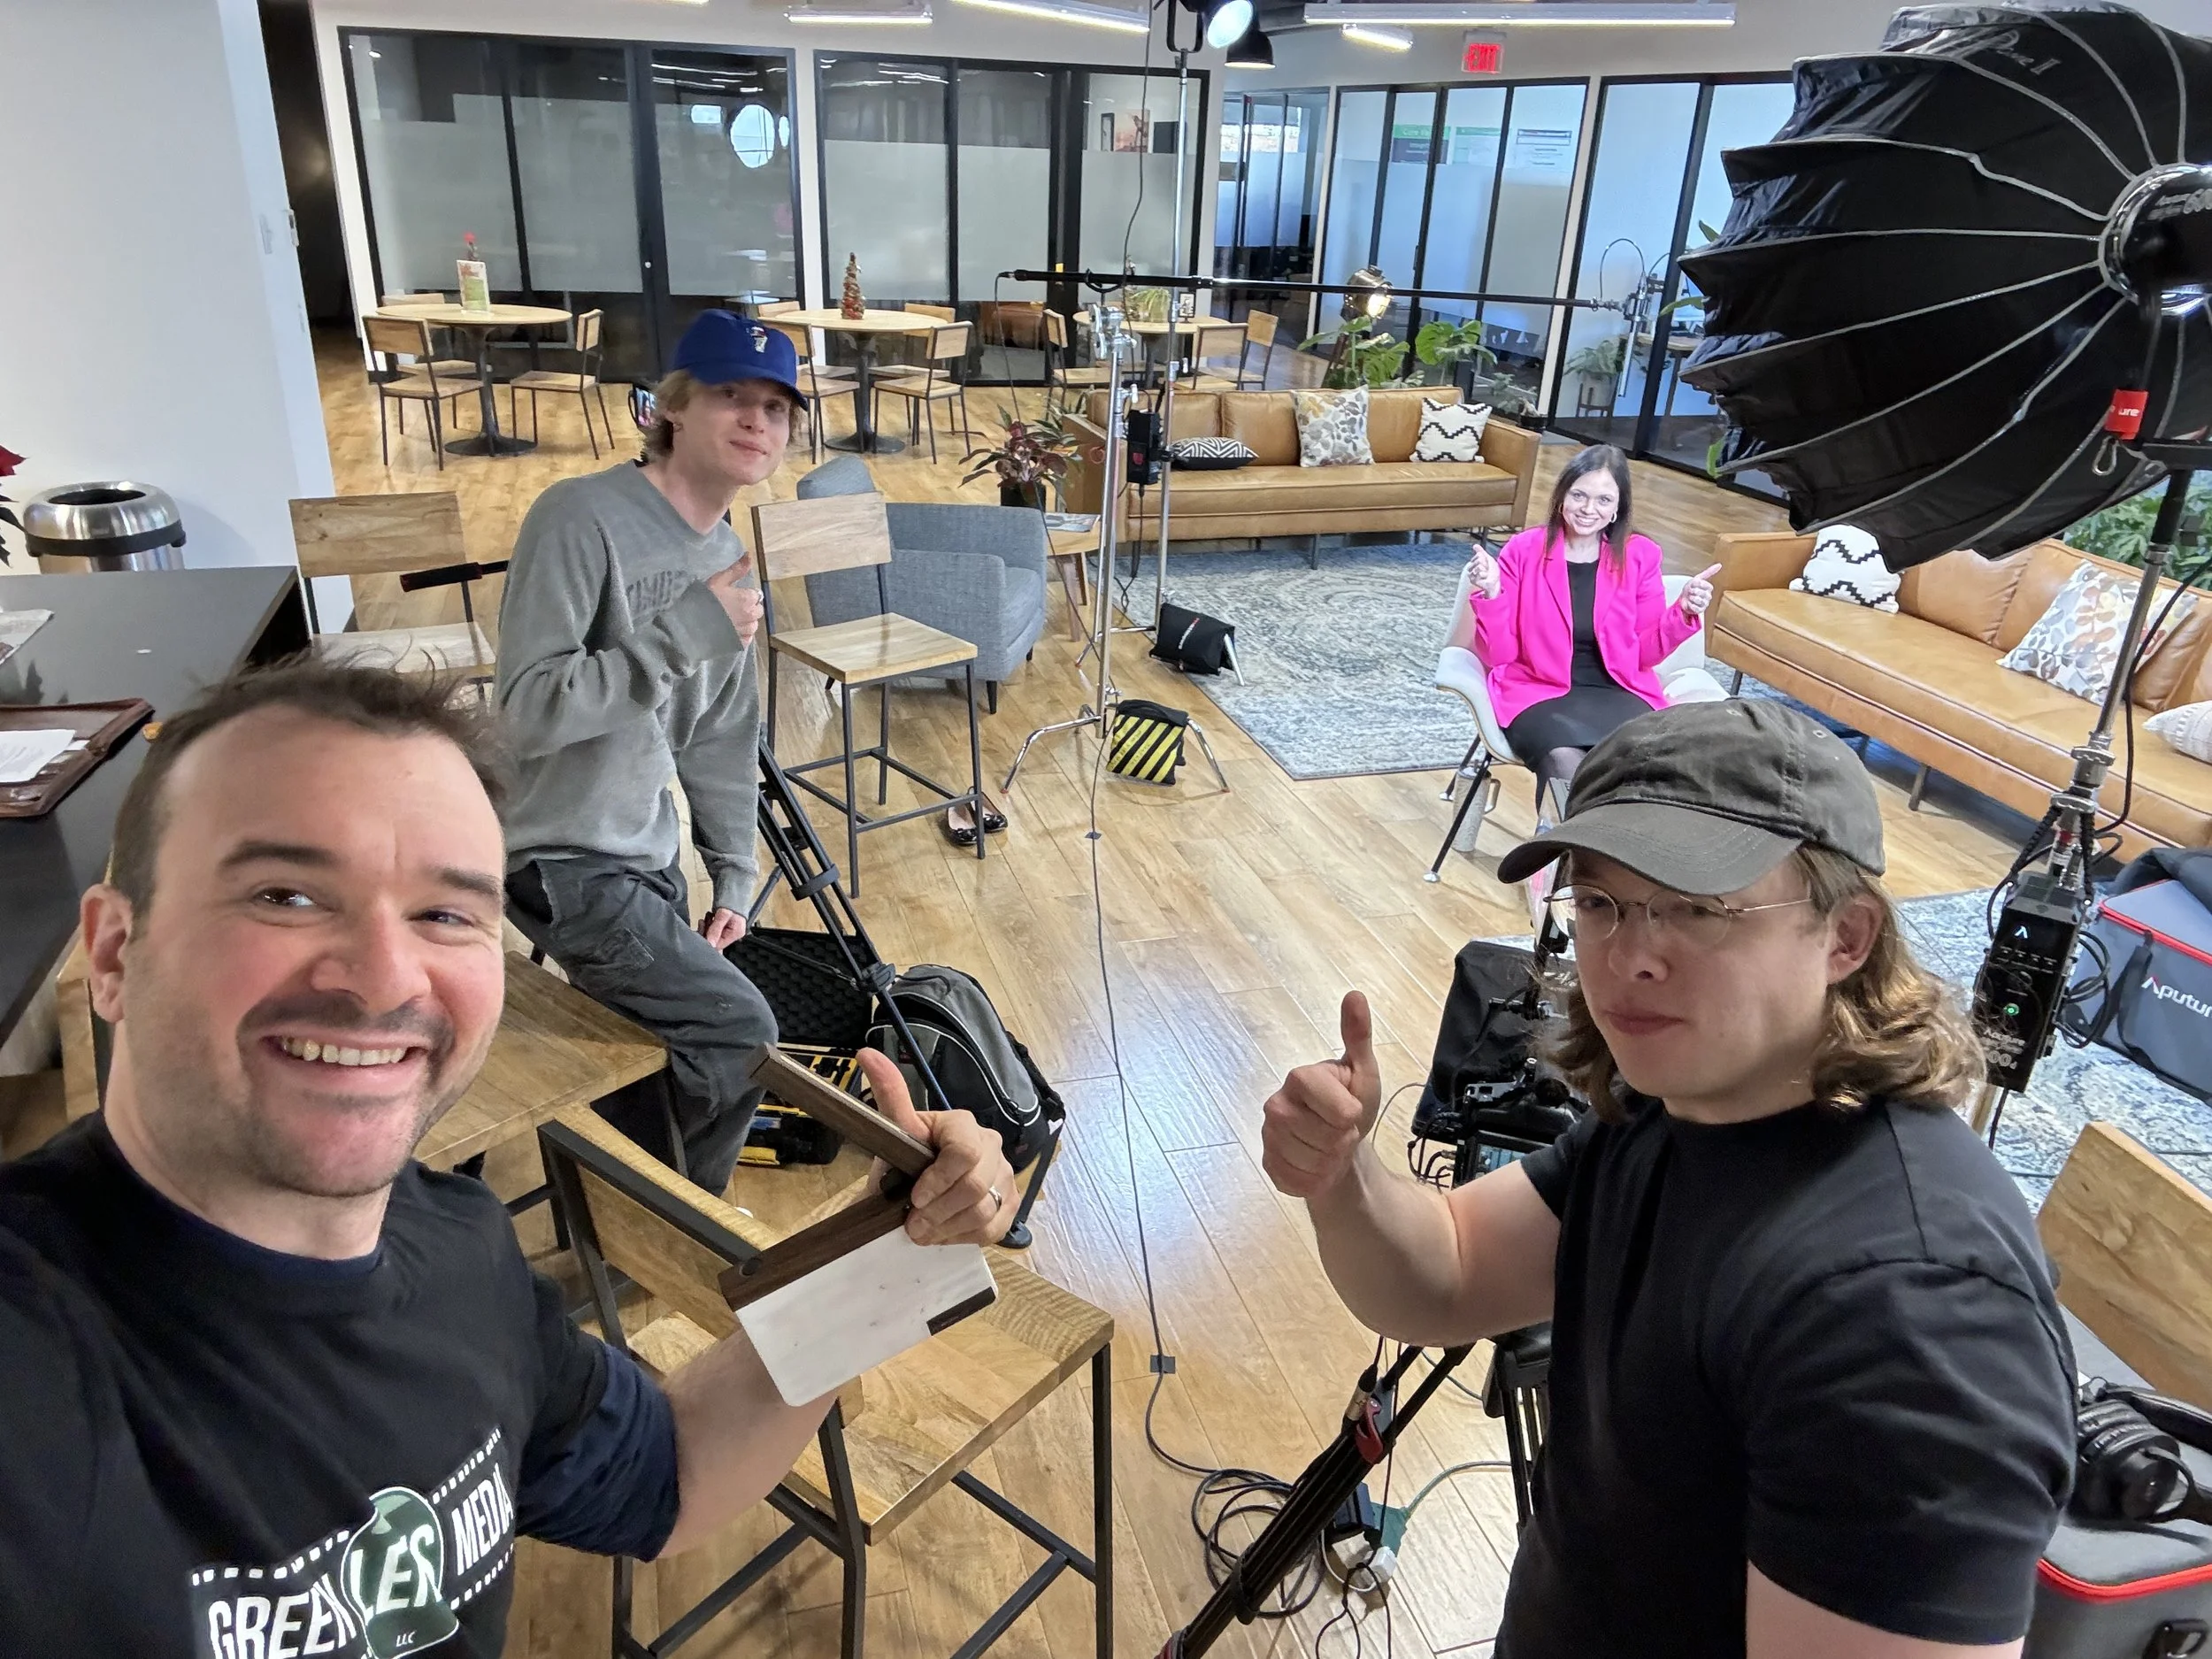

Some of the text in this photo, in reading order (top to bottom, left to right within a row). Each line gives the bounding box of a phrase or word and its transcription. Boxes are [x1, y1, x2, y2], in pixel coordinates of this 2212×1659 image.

[1468, 42, 1501, 72] EXIT
[208, 1572, 357, 1659] GREEN
[451, 1462, 515, 1577] MEDIA
[396, 1631, 416, 1647] LLC
